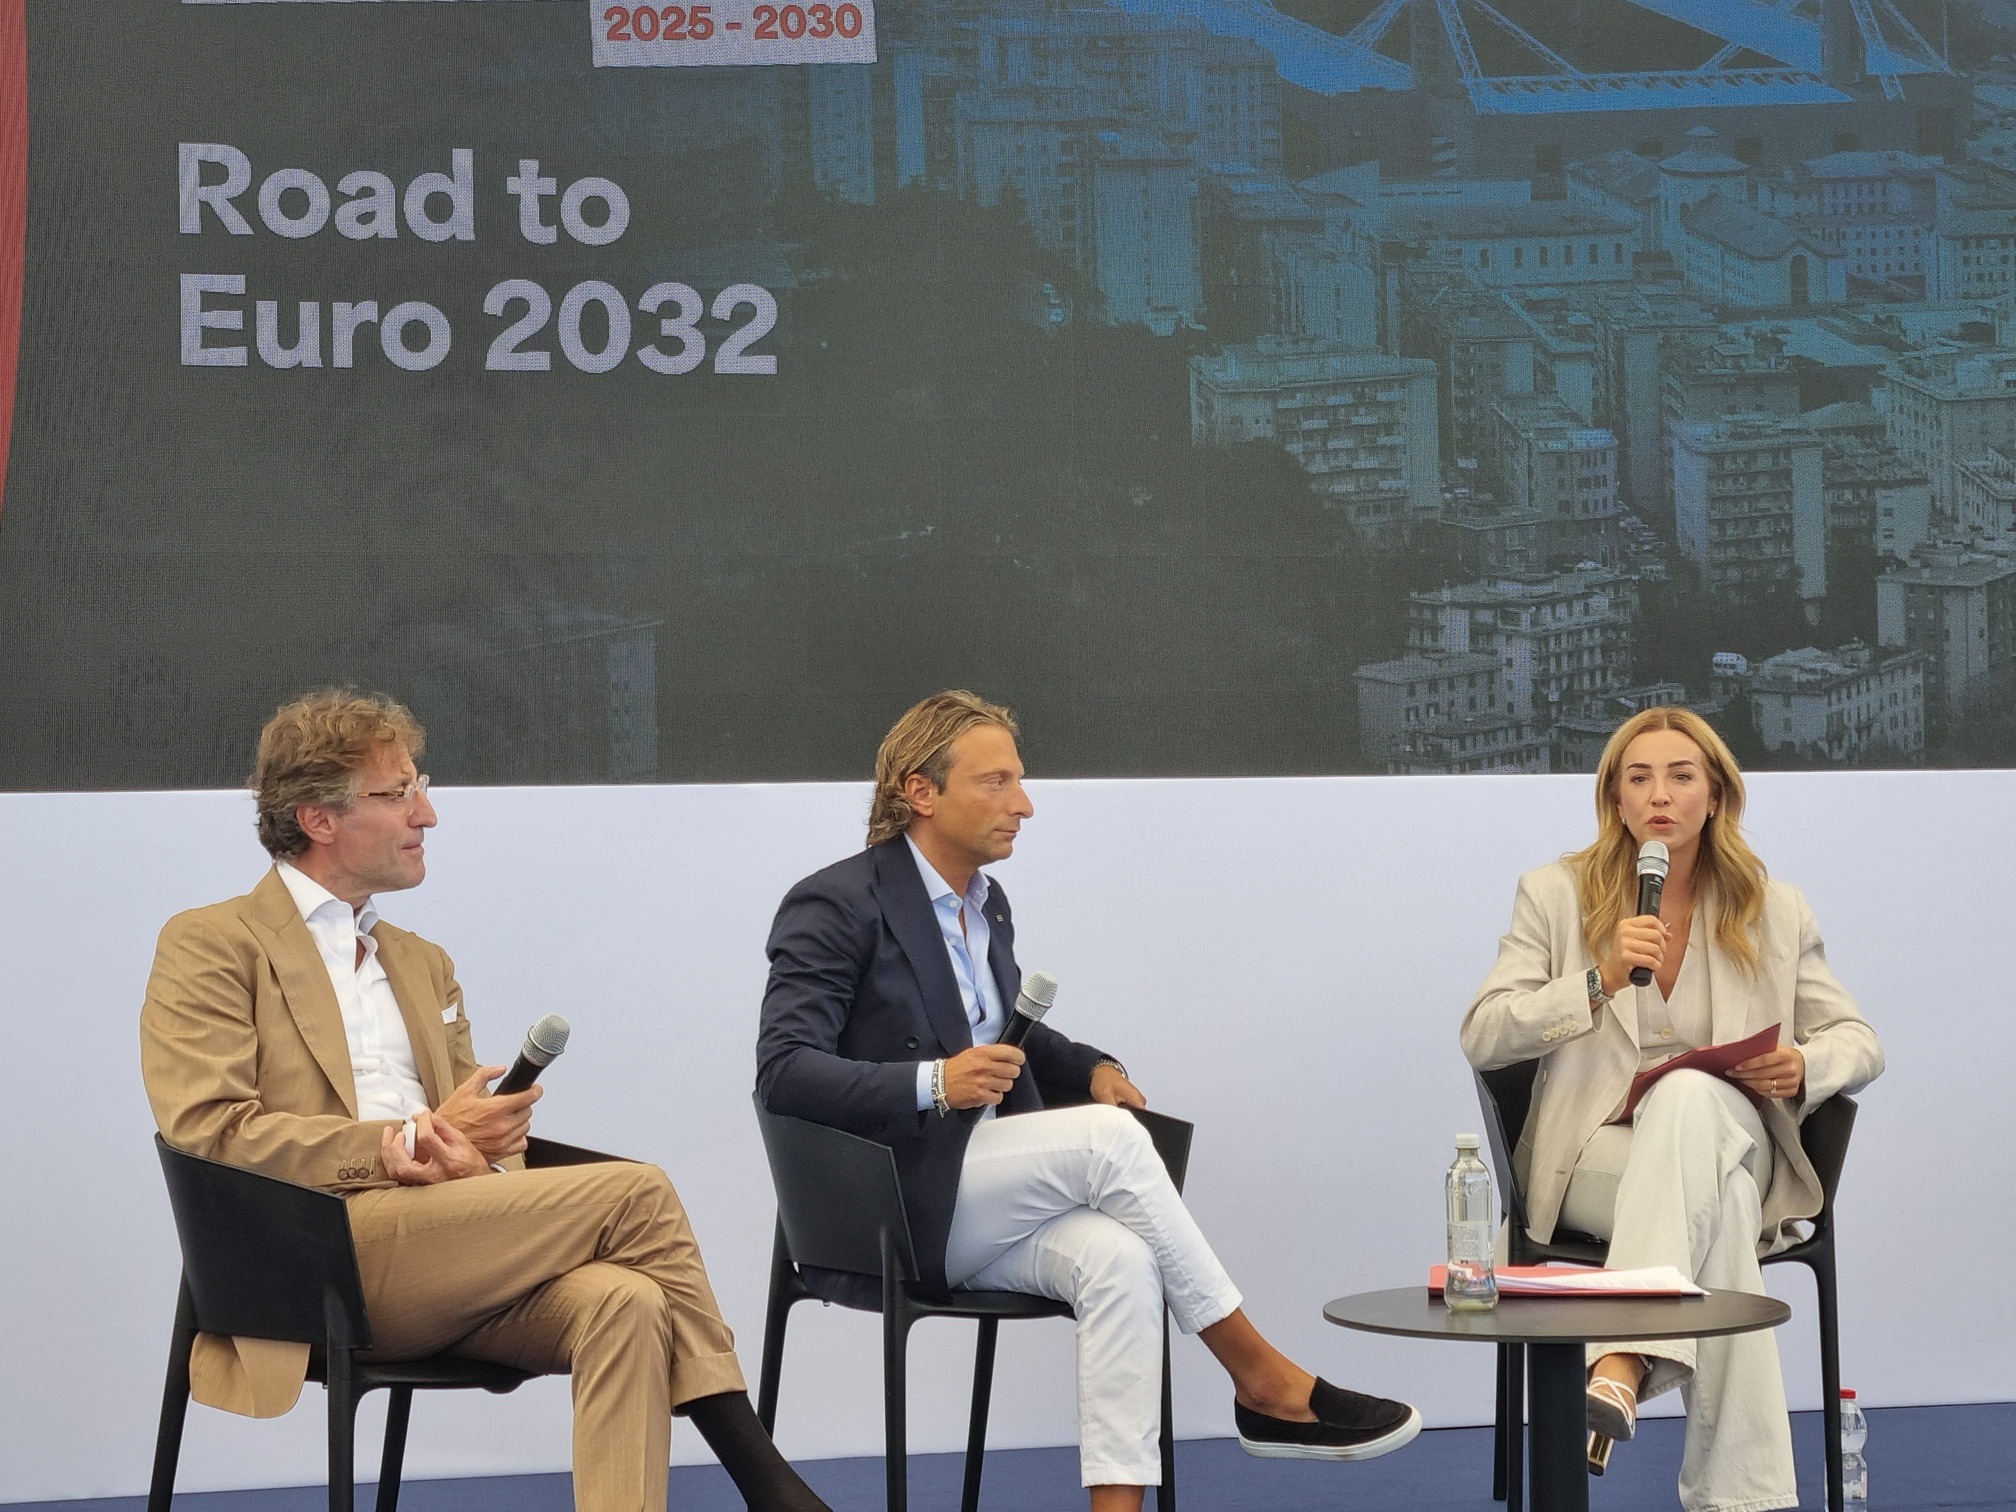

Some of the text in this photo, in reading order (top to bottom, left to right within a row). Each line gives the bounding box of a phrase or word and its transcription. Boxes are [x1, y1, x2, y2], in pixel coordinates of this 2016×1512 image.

[603, 5, 714, 41] 2025
[752, 3, 862, 40] 2030
[178, 142, 631, 246] Road to
[180, 273, 778, 375] Euro 2032
